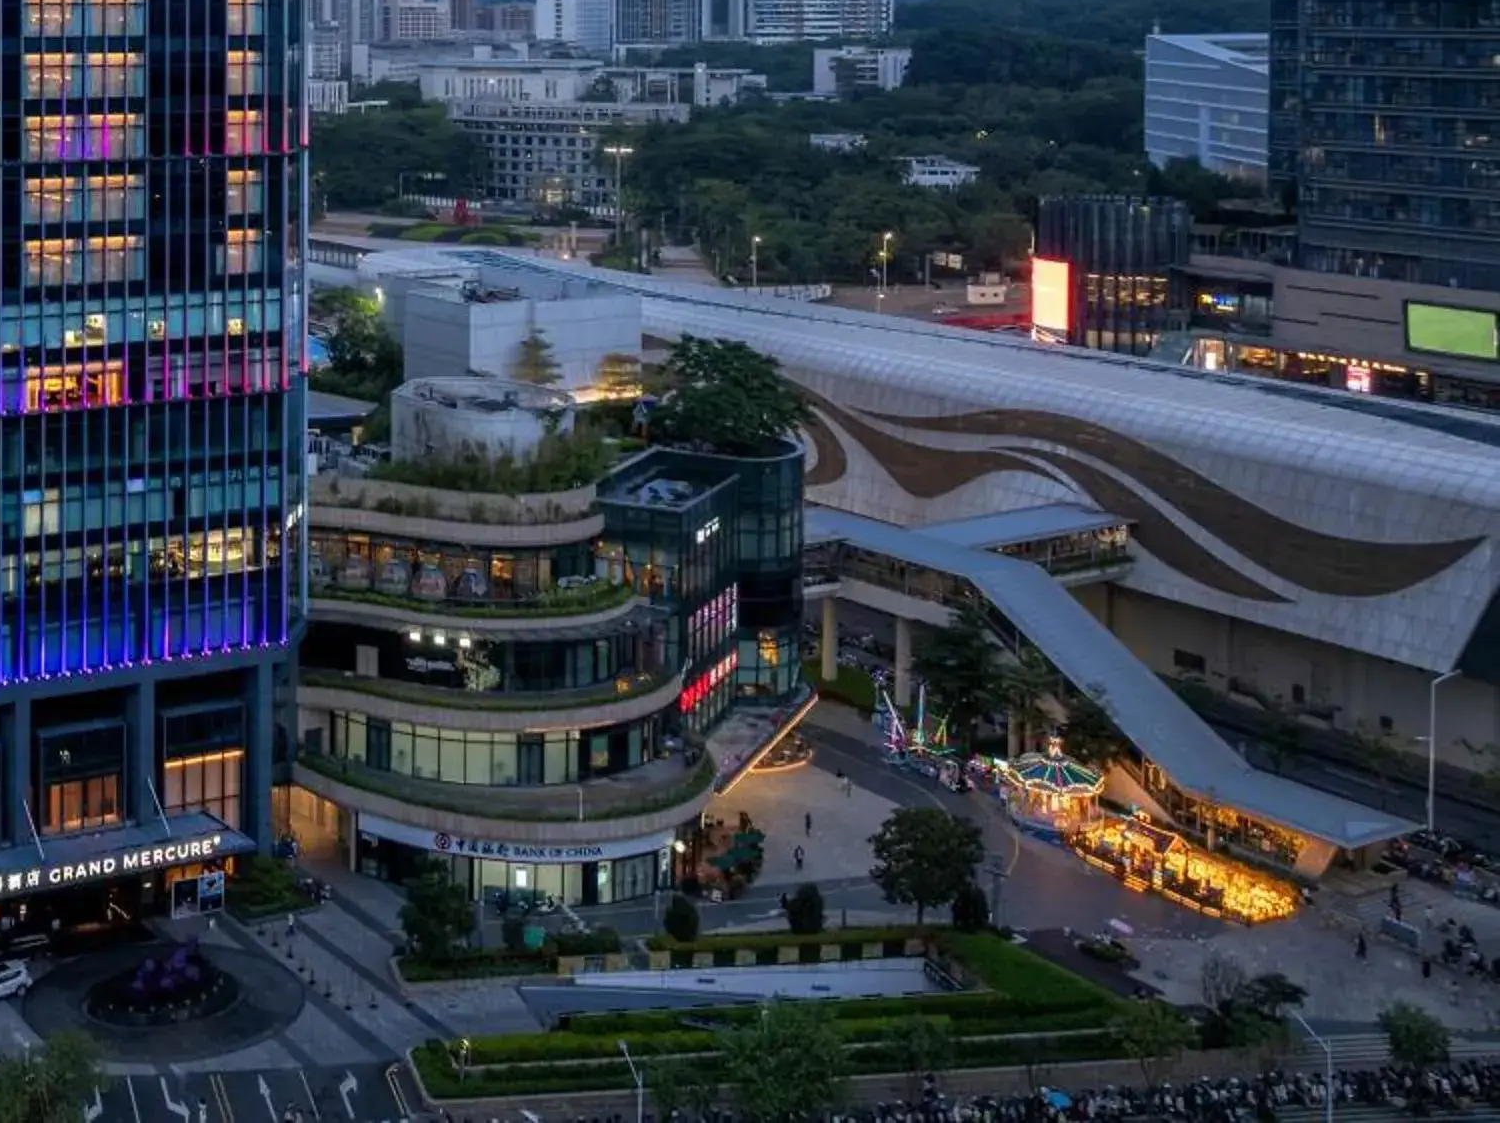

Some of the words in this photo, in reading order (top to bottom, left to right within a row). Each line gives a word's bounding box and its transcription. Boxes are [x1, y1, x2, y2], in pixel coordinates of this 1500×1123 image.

[50, 858, 116, 883] GRAND
[123, 841, 213, 869] MERCURE
[514, 847, 546, 858] BANK
[565, 846, 604, 858] CHINA
